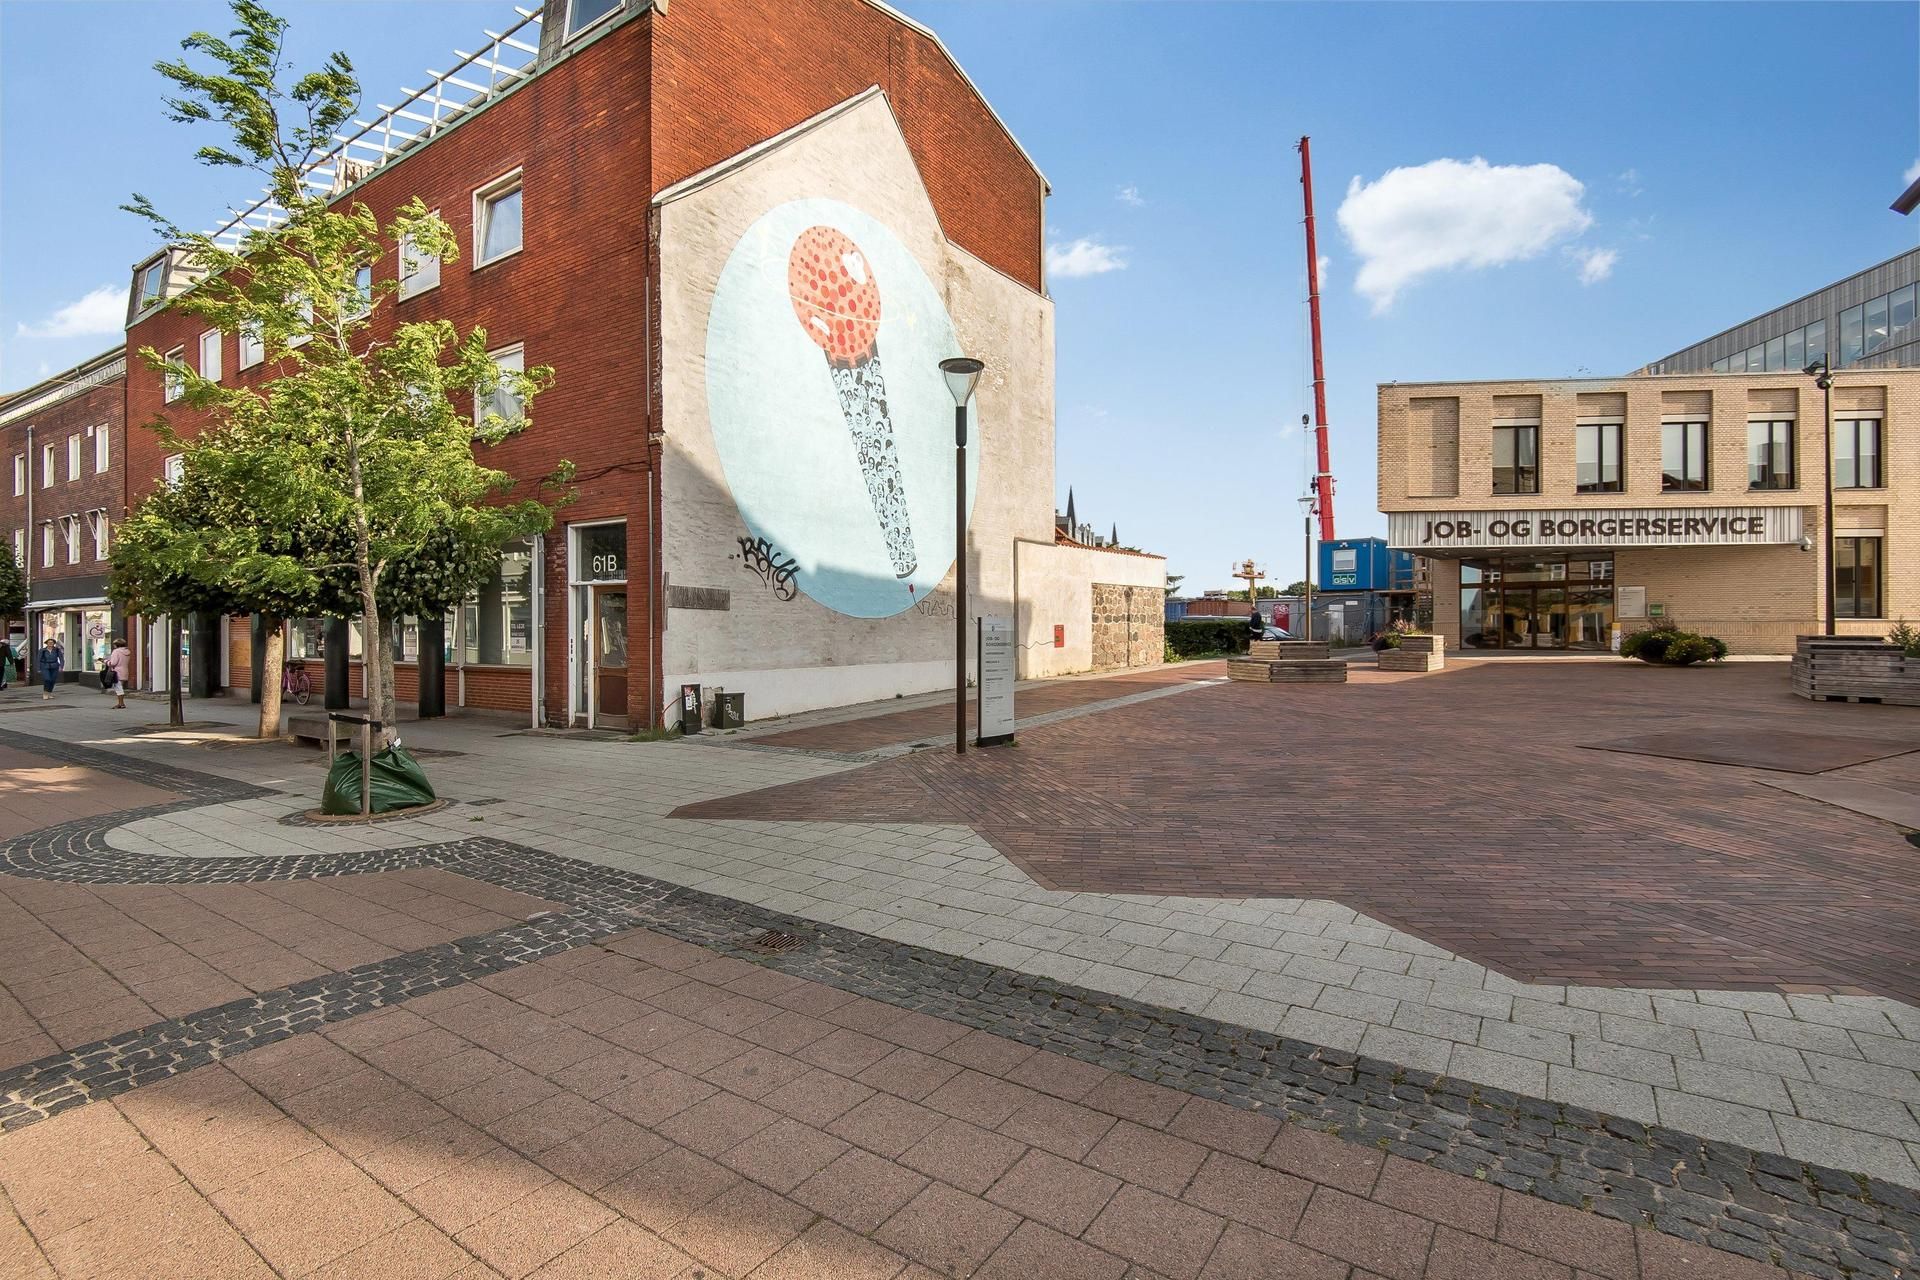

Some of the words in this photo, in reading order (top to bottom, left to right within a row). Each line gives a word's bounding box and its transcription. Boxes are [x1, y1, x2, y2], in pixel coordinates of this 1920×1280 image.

[1423, 520, 1481, 543] JOB-
[1488, 519, 1531, 538] OG
[1540, 516, 1764, 538] BORGERSERVICE
[593, 554, 617, 573] 61B
